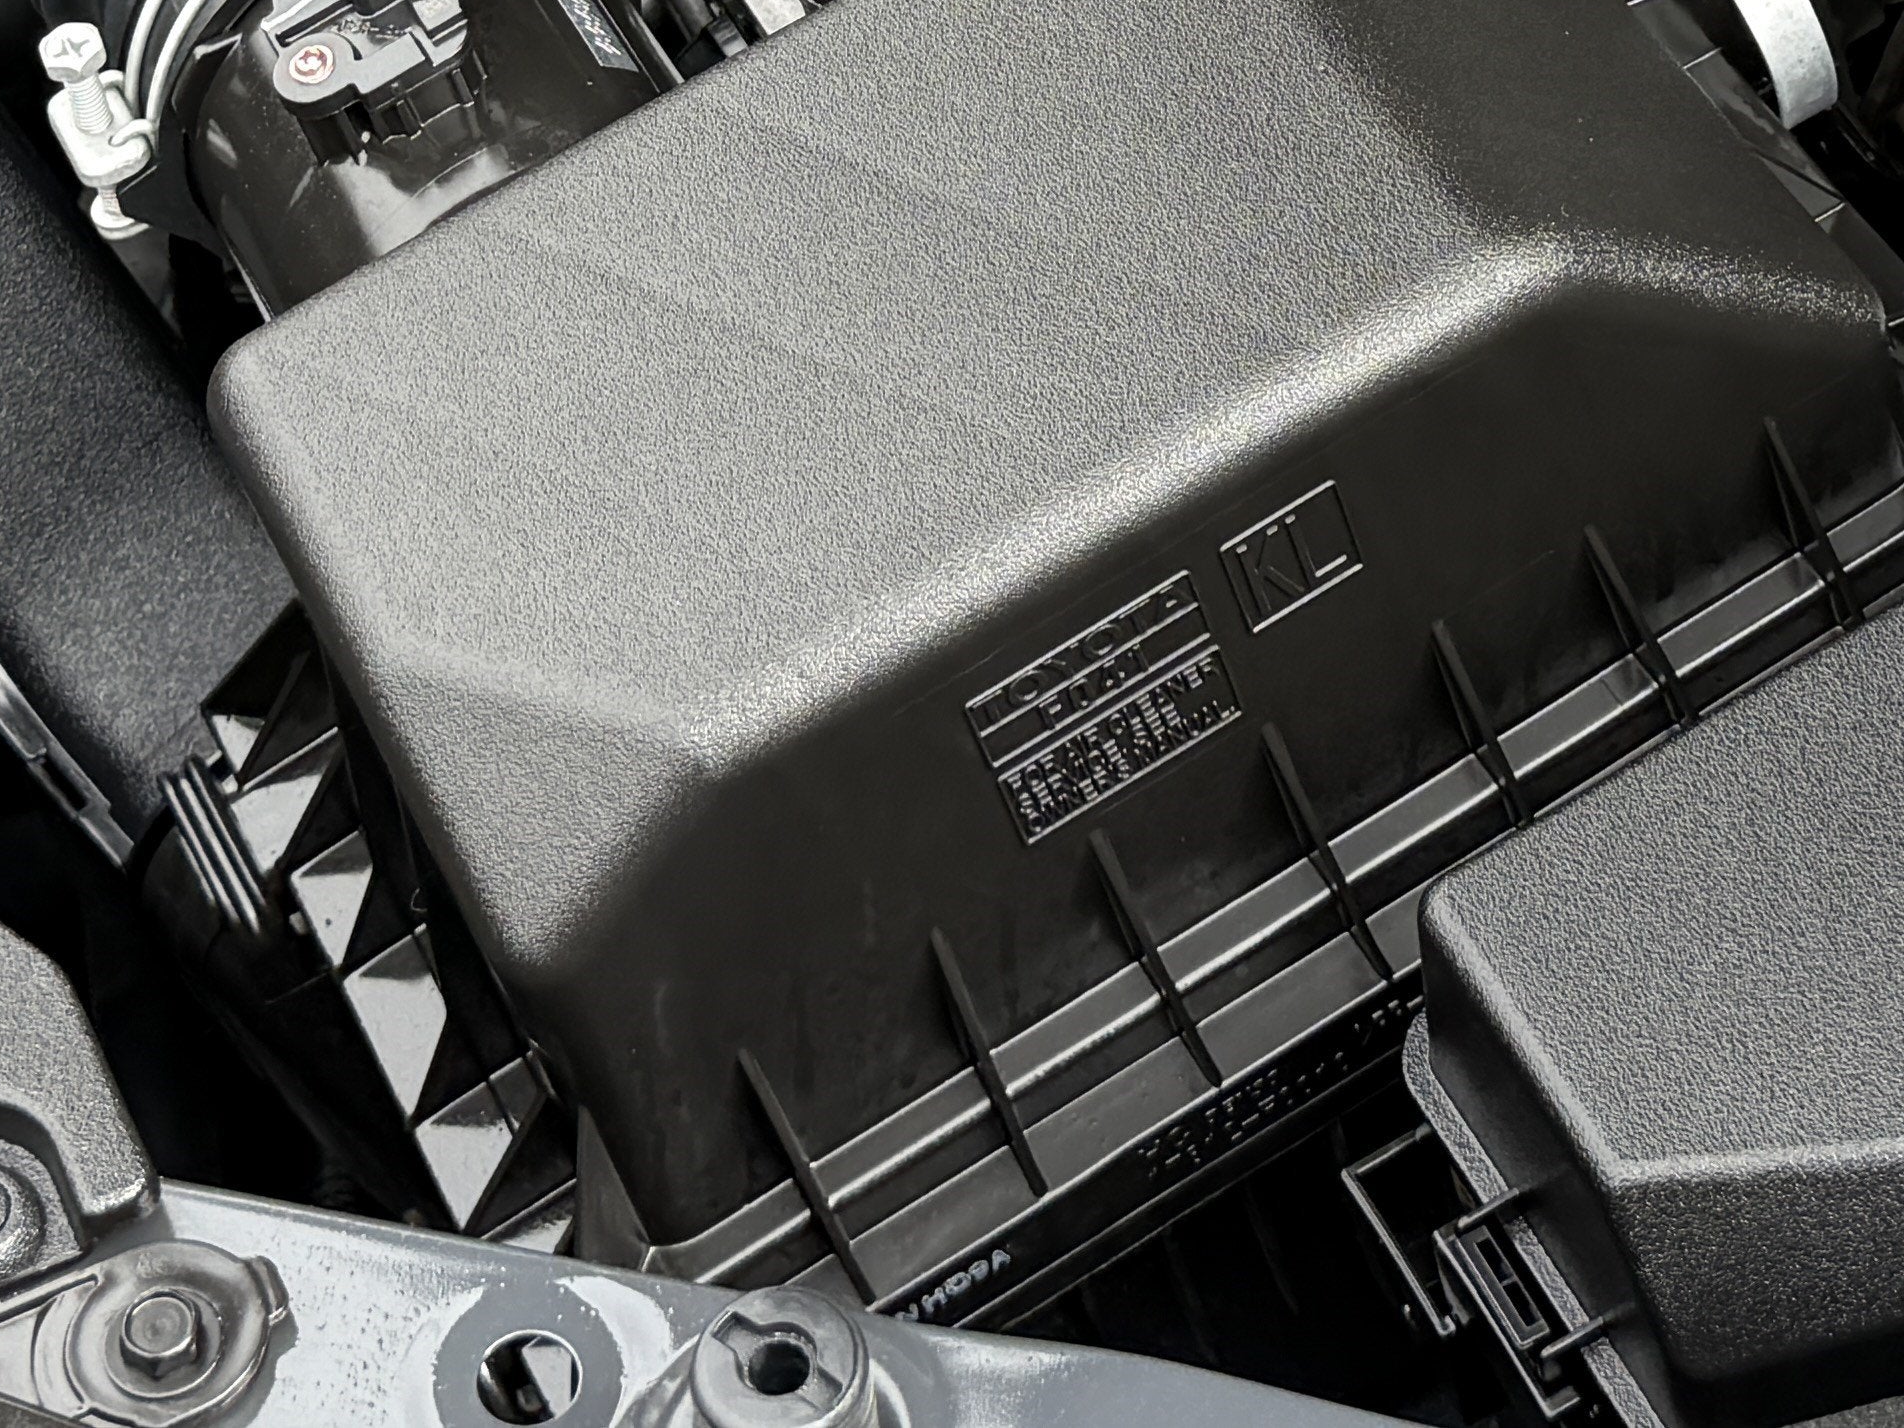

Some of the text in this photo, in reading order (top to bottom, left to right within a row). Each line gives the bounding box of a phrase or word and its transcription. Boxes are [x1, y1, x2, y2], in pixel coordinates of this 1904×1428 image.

[1235, 513, 1349, 613] KL
[972, 584, 1197, 725] TOYOTA
[1006, 656, 1221, 795] FOR AIR CLEANER
[1130, 702, 1182, 747] SEE
